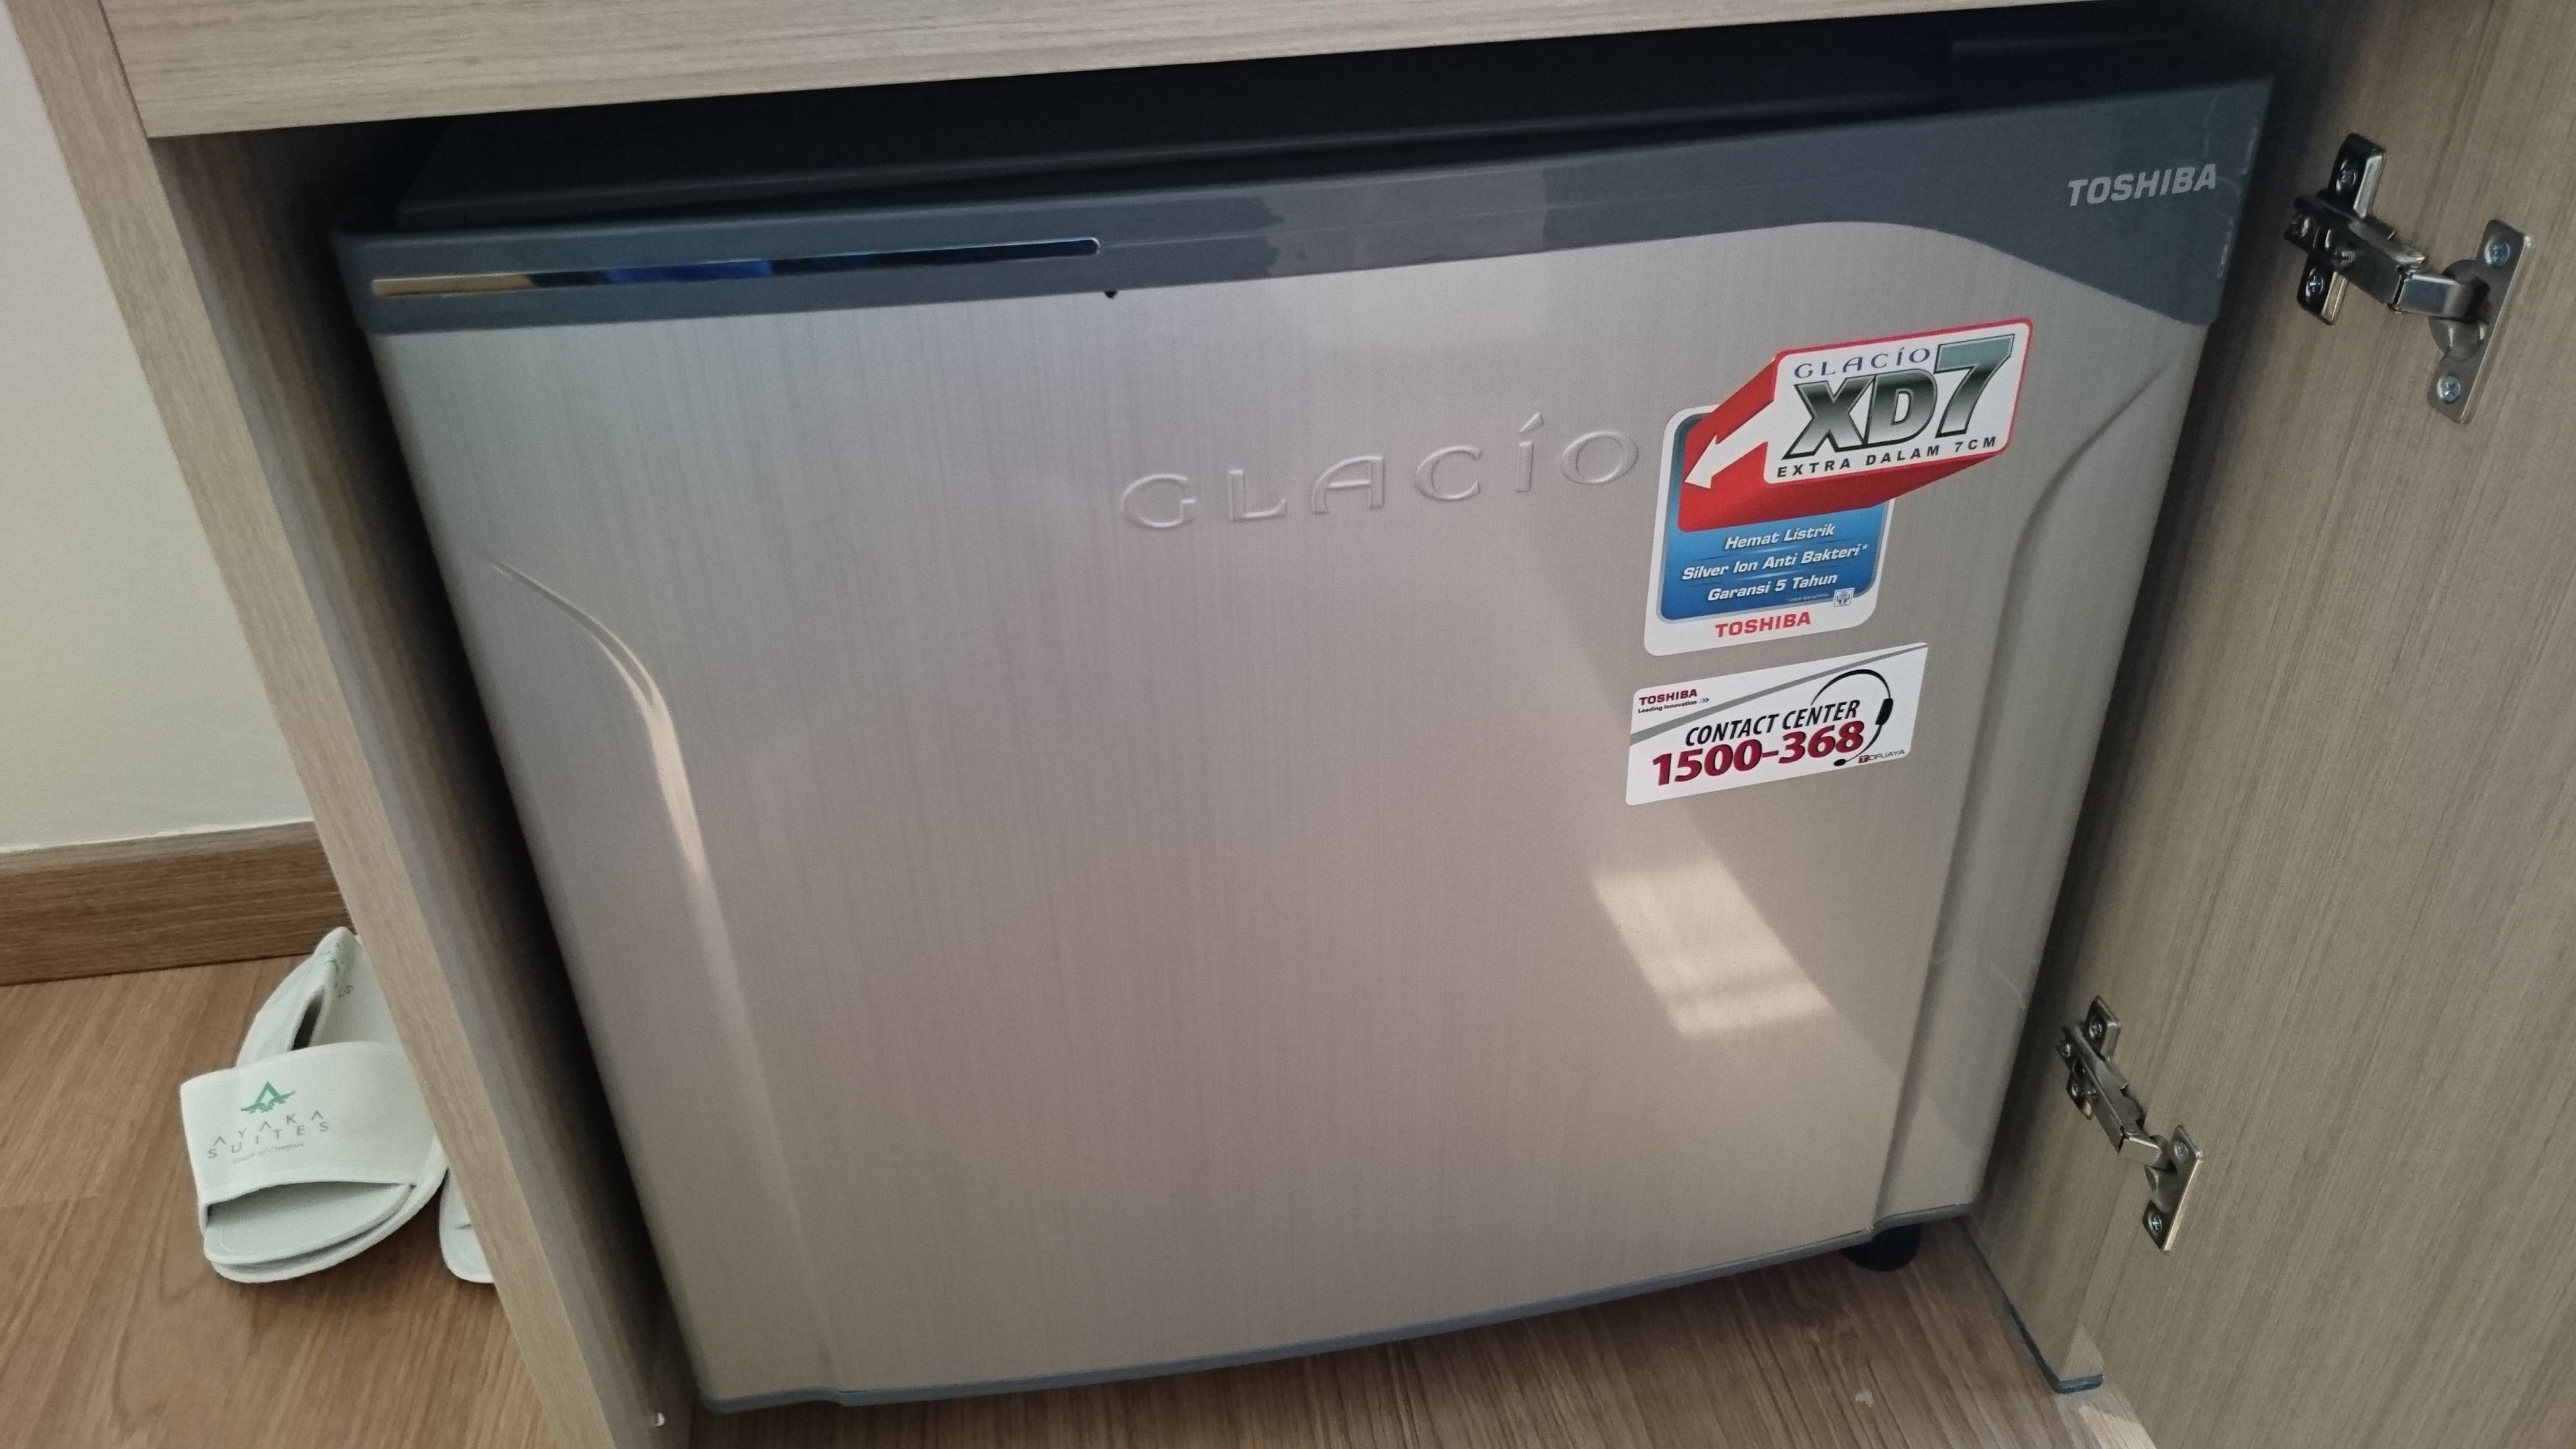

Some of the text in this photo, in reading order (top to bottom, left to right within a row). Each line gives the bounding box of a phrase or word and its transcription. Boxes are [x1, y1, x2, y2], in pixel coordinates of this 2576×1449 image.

[2068, 163, 2216, 207] TOSHIBA
[1782, 333, 2015, 460] XD7
[1777, 436, 1997, 478] EXTRA DALAM 7CM
[1724, 523, 1836, 550] Hemat Listrik
[1682, 564, 1729, 580] Silver
[1733, 560, 1758, 574] Ion
[1762, 553, 1799, 569] Anti
[1707, 581, 1771, 601] Garansi
[1775, 579, 1786, 592] 5
[1792, 574, 1838, 590] Tahun
[1715, 611, 1812, 639] TOSHIBA
[1638, 700, 1697, 714] Leading Innovation
[1639, 689, 1698, 706] TOSHIBA
[1685, 699, 1860, 747] CONTACT CENTER
[1652, 720, 1864, 786] 1500-368
[208, 1121, 329, 1159] SUITES
[213, 1110, 324, 1146] AYAKA
